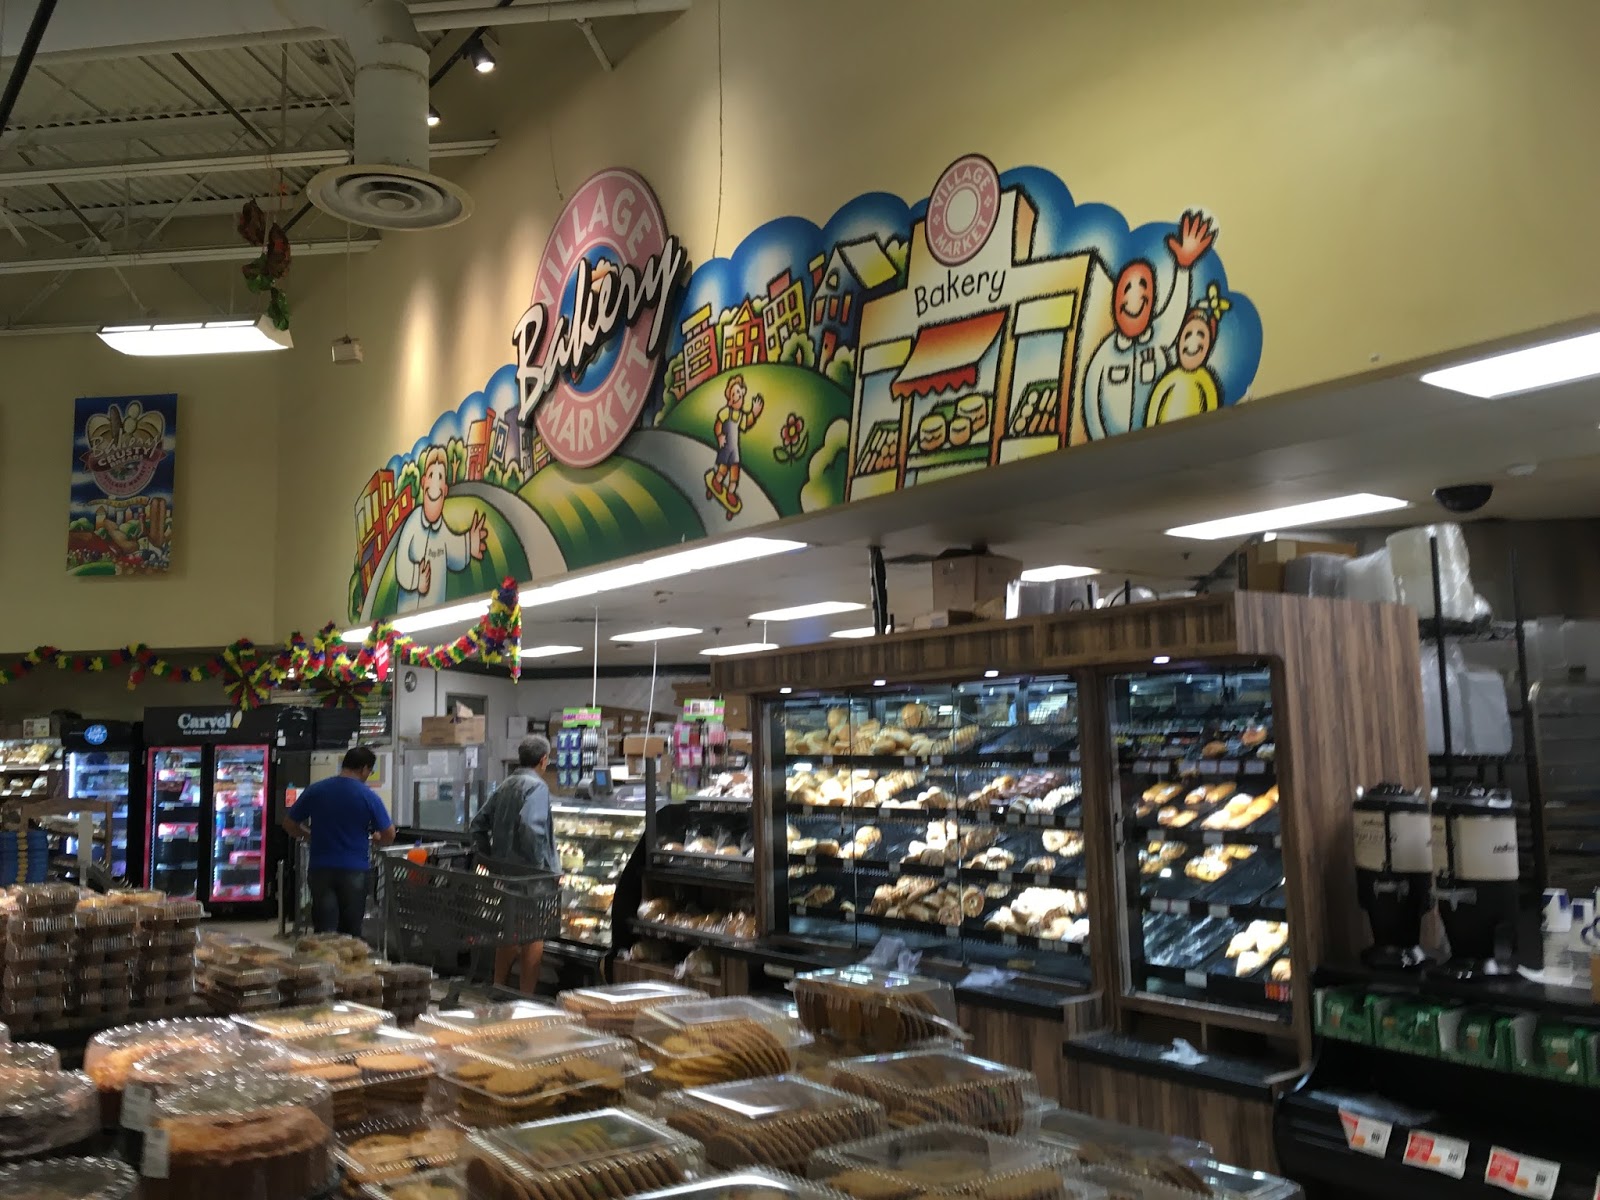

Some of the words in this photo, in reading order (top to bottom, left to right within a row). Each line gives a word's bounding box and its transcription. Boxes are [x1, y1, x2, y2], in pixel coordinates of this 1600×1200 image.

[934, 166, 992, 208] VILLAGE
[534, 186, 652, 306] VILLAGE
[935, 215, 989, 256] MARKET
[914, 268, 1007, 319] Bakery
[513, 234, 684, 422] Bakery
[540, 336, 650, 453] MARKET
[97, 446, 151, 467] CRUSTY
[177, 711, 232, 730] Carvel
